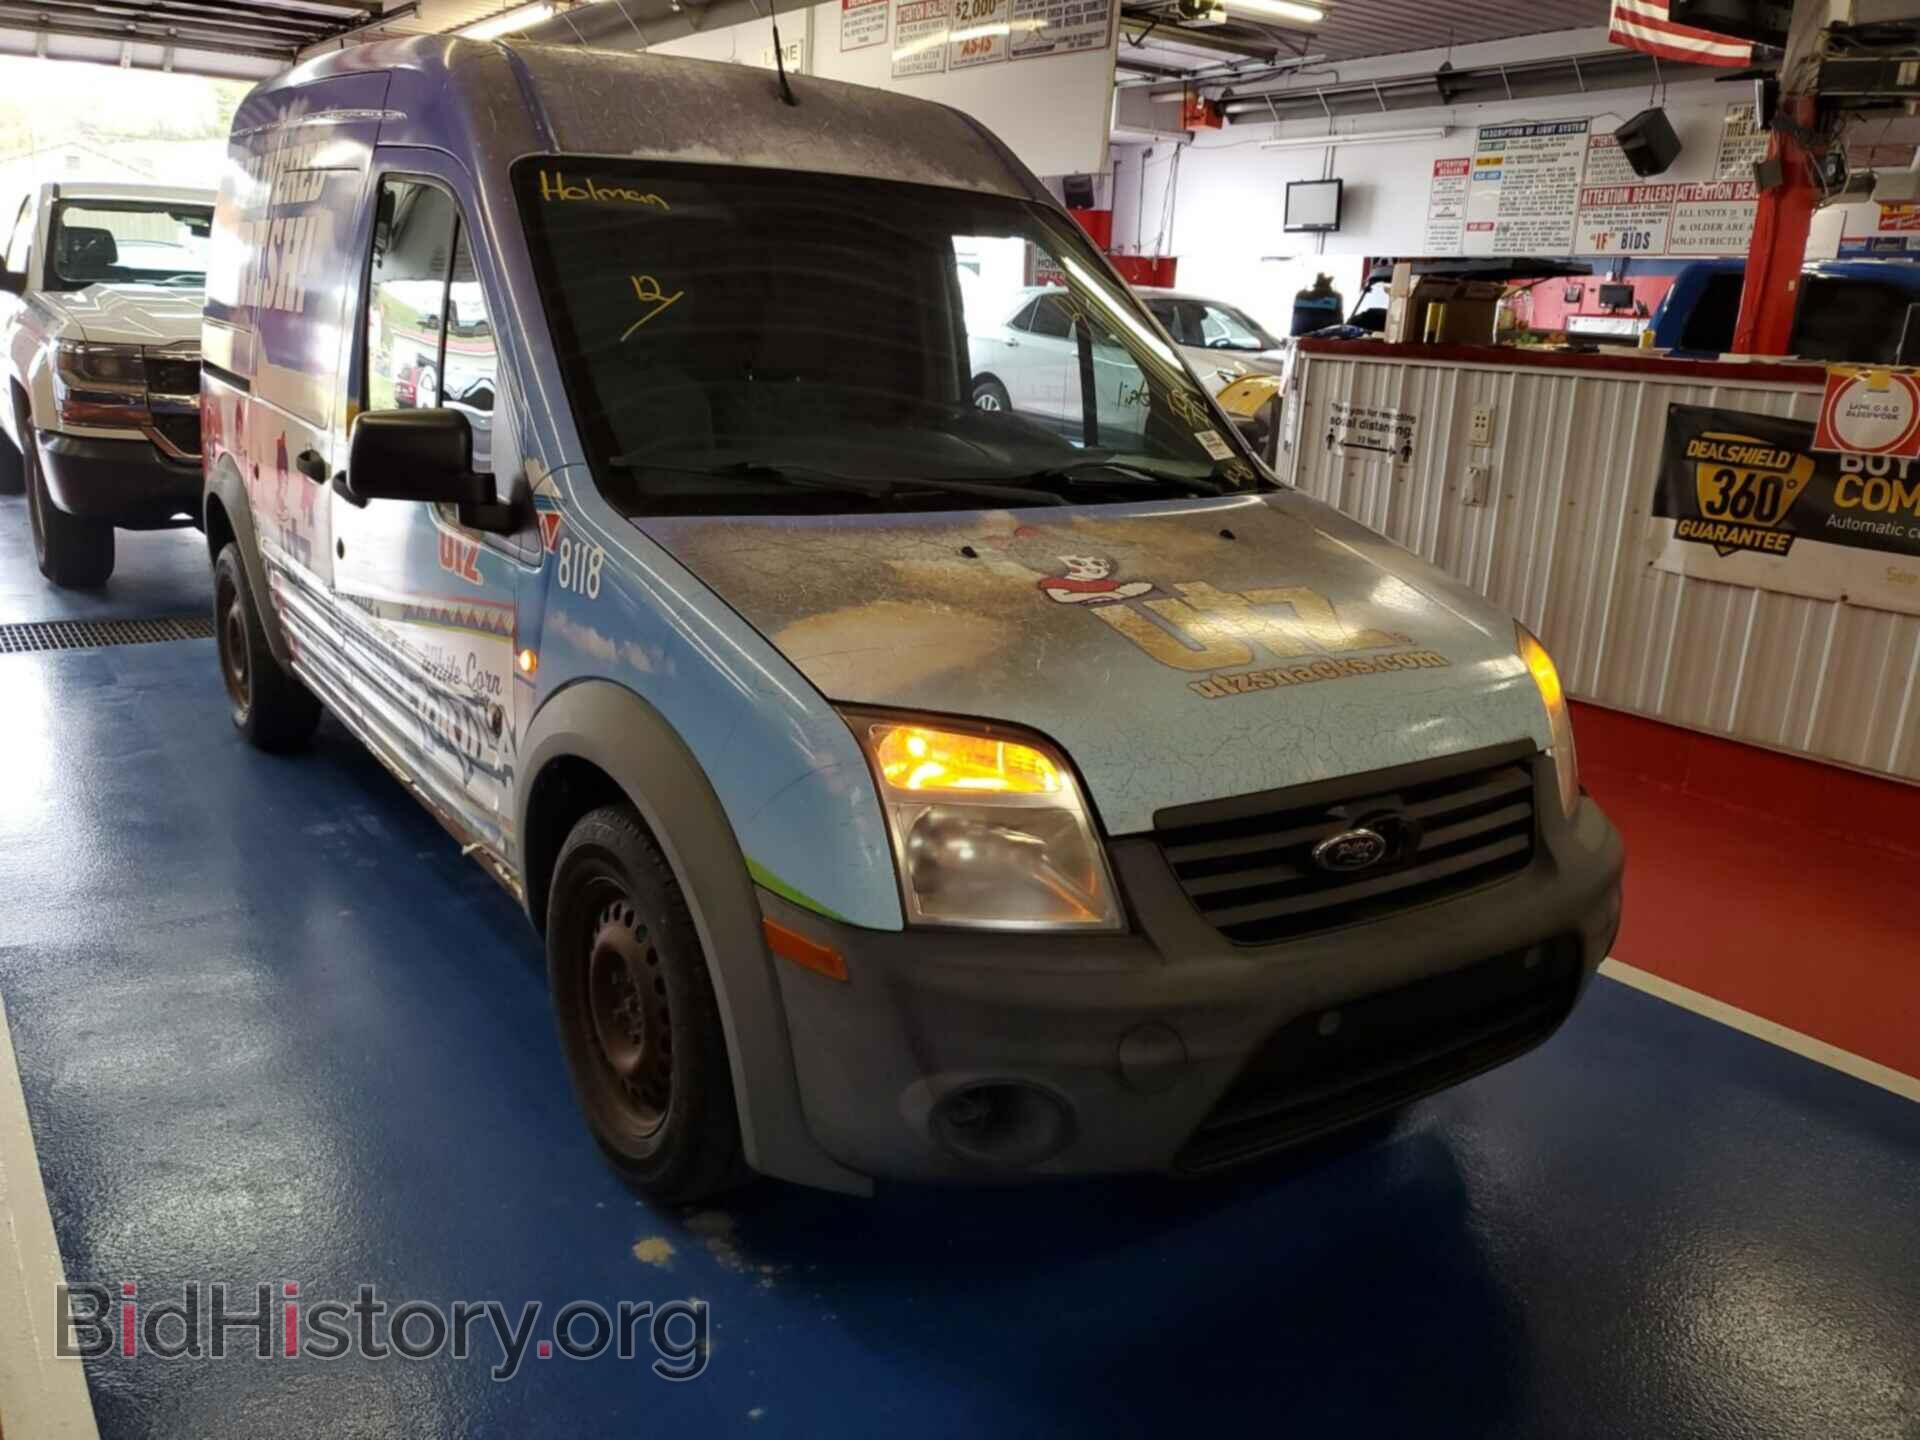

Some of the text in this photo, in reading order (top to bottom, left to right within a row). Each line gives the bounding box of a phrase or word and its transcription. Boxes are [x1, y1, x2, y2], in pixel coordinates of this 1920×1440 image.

[764, 44, 799, 65] LNE
[539, 169, 671, 210] Holman
[1582, 185, 1673, 205] ATTENTION DEALERS
[1678, 181, 1758, 201] ATTENTION DEA
[1689, 222, 1722, 232] OLDER
[1620, 231, 1651, 250] BIDS
[1329, 415, 1414, 439] soal distanng.
[1686, 438, 1792, 469] DEALSHIELD
[1839, 453, 1912, 480] BUY
[1677, 519, 1791, 551] GUARANTEE
[1825, 513, 1904, 538] Automatic
[557, 536, 604, 600] 8118
[464, 650, 503, 697] Corn
[1188, 650, 1452, 698] utzsnacks.com
